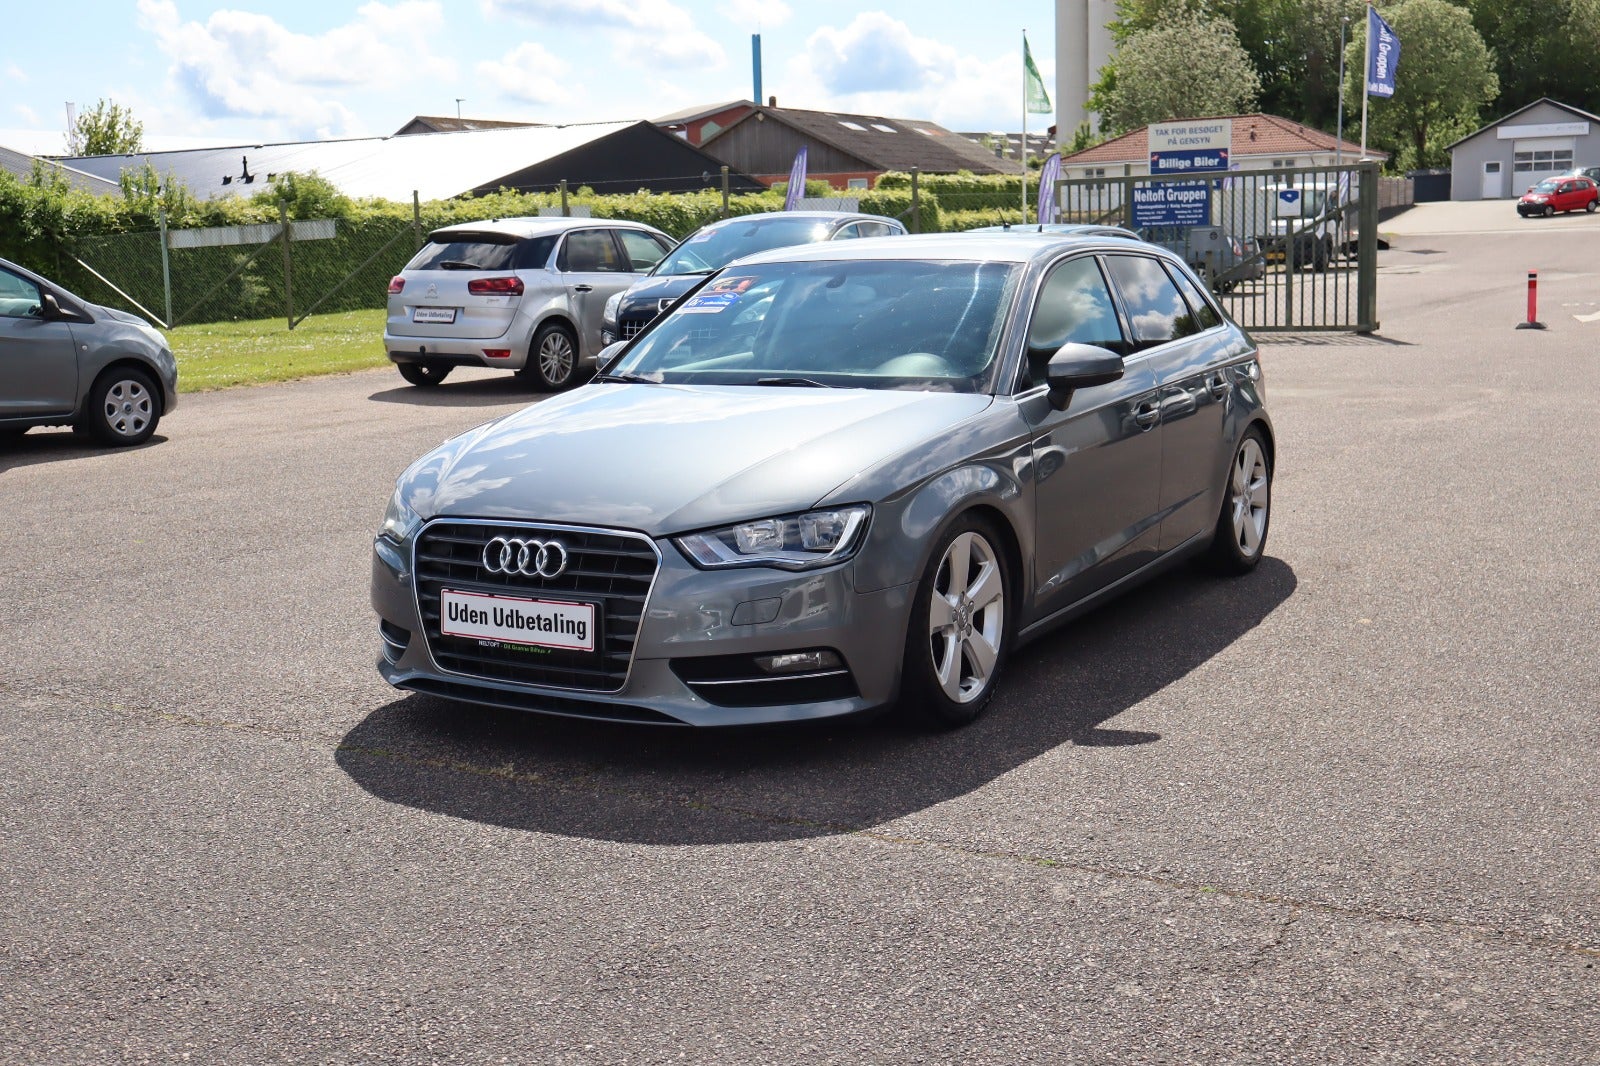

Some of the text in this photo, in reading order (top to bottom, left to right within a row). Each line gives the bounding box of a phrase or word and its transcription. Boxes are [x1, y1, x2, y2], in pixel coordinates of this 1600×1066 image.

[1189, 125, 1224, 134] BESØGET
[1167, 137, 1211, 145] PÅ GENSYN
[1158, 156, 1220, 169] Billige Biler
[1134, 188, 1206, 203] Neltoft Gruppen
[448, 601, 587, 641] Uden Udbetaling
